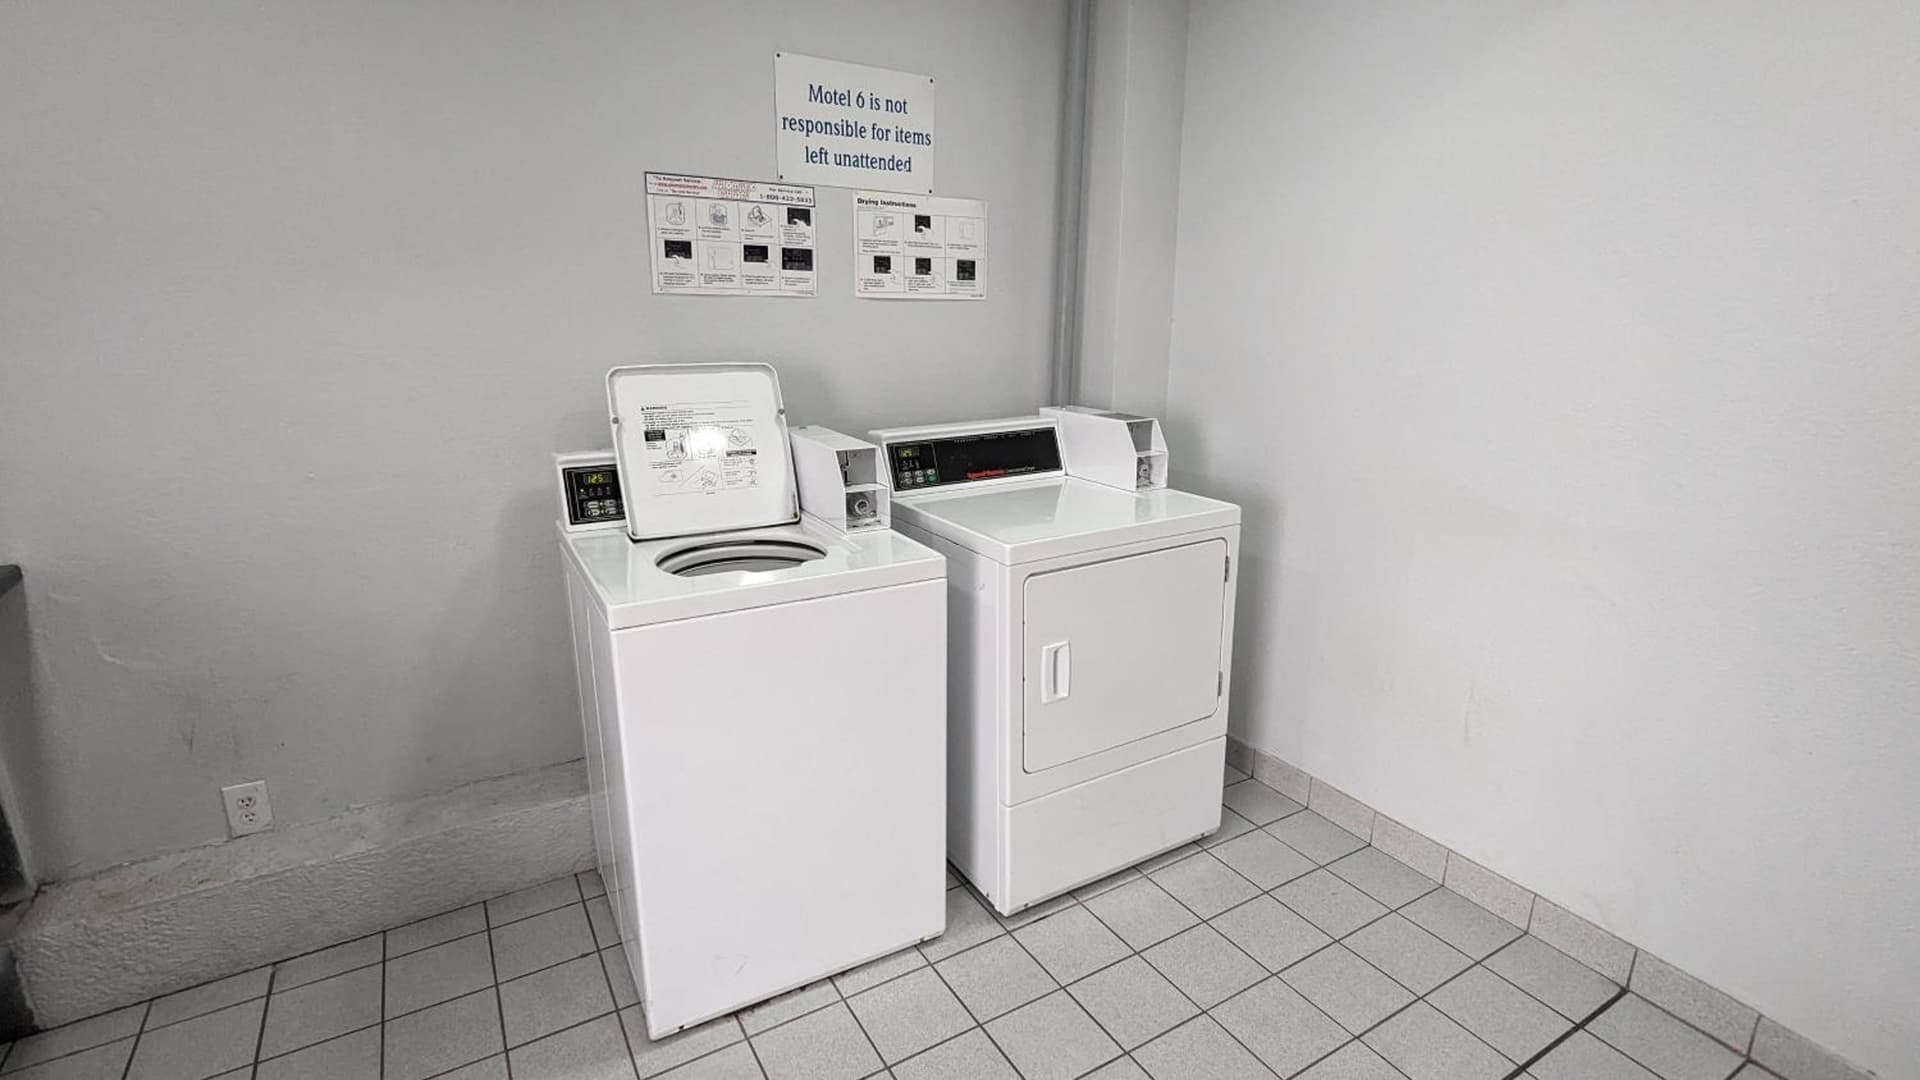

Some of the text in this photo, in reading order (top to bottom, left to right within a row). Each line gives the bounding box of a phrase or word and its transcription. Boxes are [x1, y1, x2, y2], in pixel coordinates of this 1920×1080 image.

[808, 83, 908, 115] Motel 6 is not
[782, 116, 932, 146] responsible for items
[805, 145, 912, 172] left unattended
[857, 197, 879, 206] Drying
[880, 199, 917, 208] Instructions
[587, 473, 604, 484] 125
